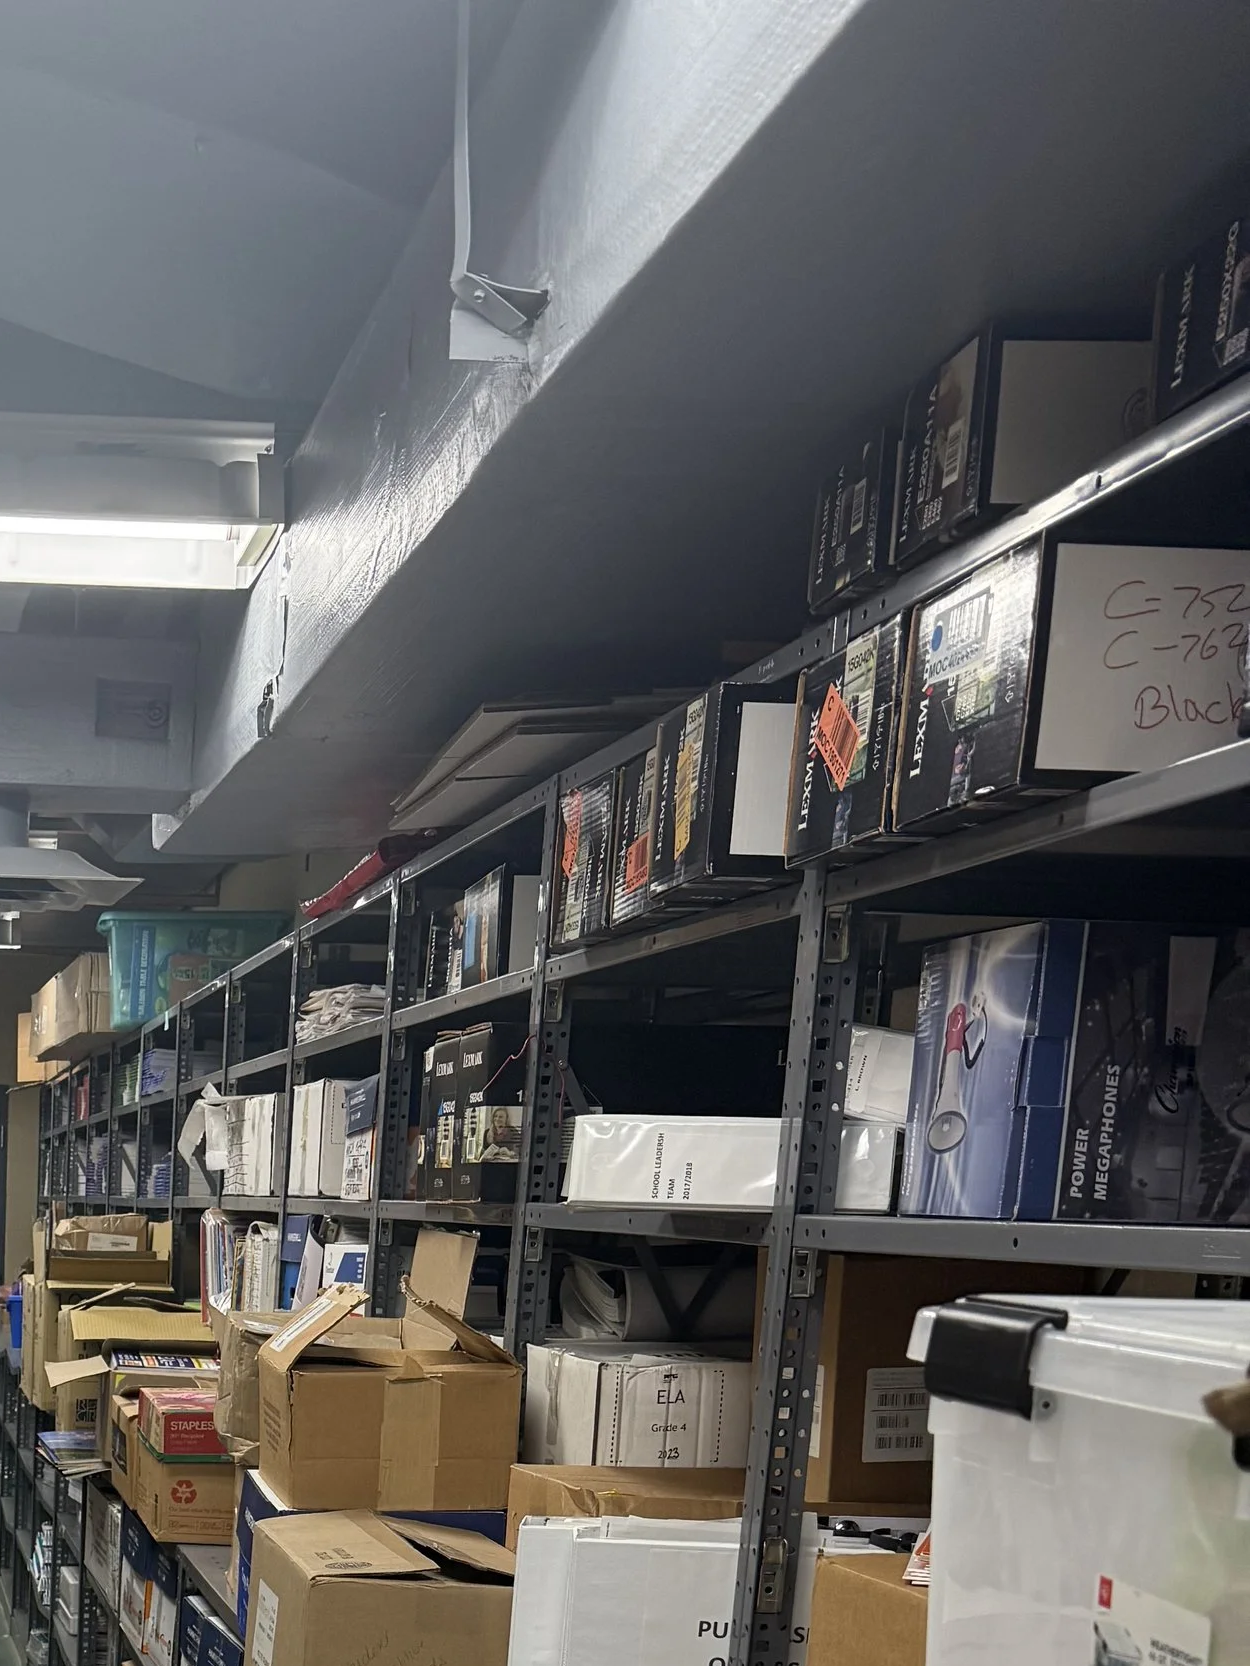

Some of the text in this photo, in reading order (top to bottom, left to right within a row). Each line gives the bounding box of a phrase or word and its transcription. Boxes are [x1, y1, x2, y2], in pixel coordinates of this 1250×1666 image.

[1134, 682, 1244, 729] Black
[436, 1060, 454, 1077] LEXMARK
[462, 1051, 483, 1068] LEXMARK
[1094, 1064, 1120, 1200] MEGAPHONES
[652, 1132, 665, 1199] SCHOOL LEADERSH
[1070, 1128, 1089, 1198] POWER
[667, 1179, 675, 1199] TEAM
[683, 1162, 693, 1200] 2017/2018
[657, 1389, 685, 1404] ELA
[170, 1421, 214, 1431] STAPLES
[651, 1424, 677, 1432] Grade
[658, 1447, 679, 1460] 2023
